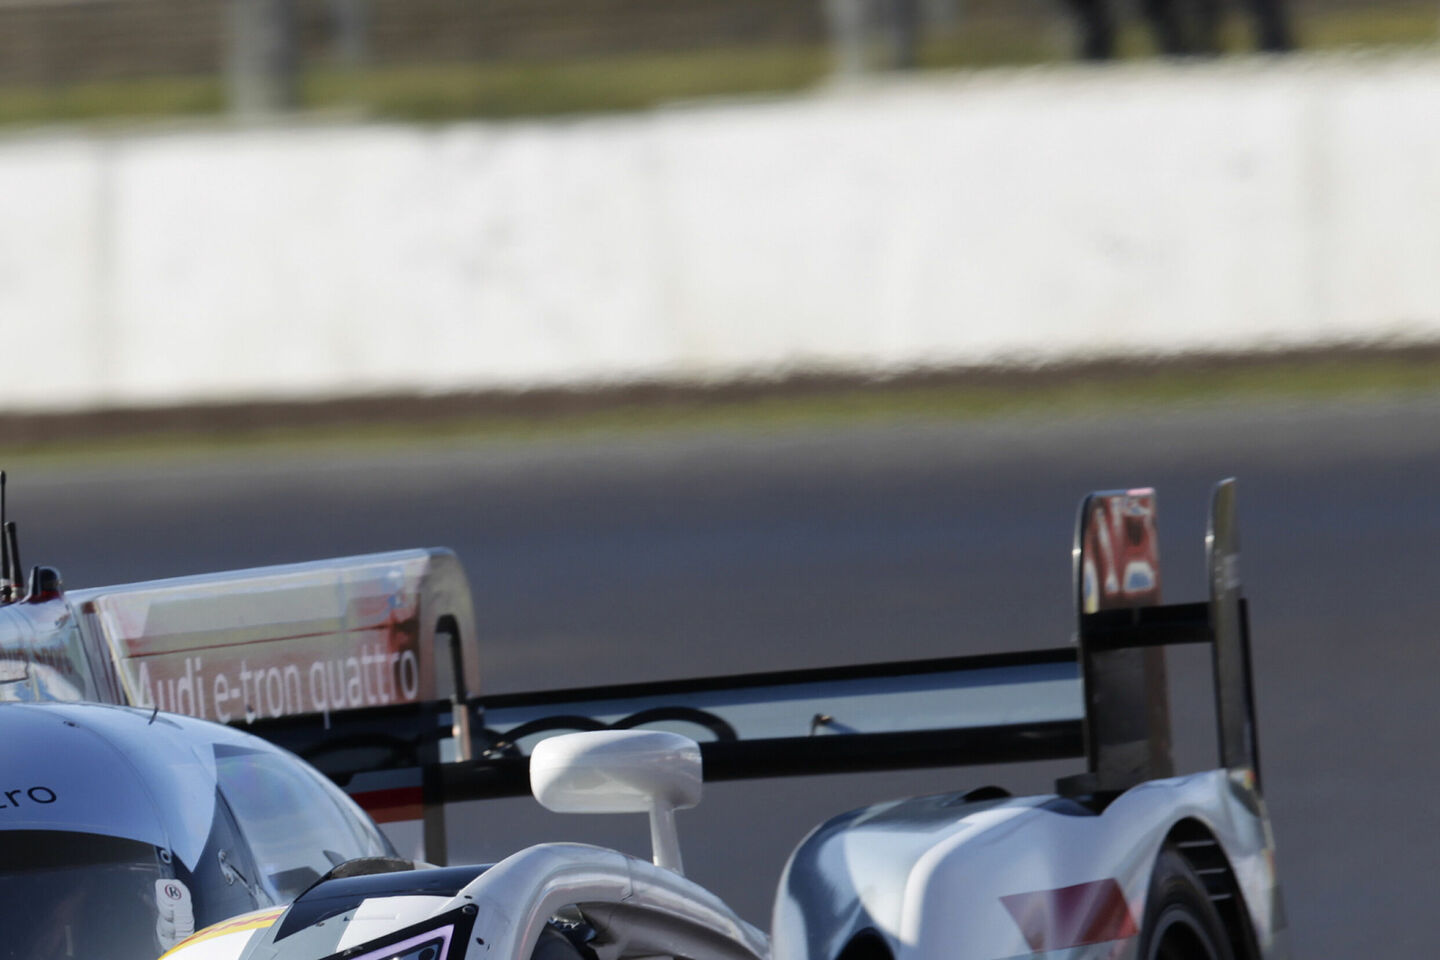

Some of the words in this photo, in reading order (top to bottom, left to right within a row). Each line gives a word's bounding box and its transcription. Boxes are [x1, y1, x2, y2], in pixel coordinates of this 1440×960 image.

[134, 655, 209, 718] Audi
[213, 660, 303, 723] e-tron
[310, 643, 419, 729] quattro
